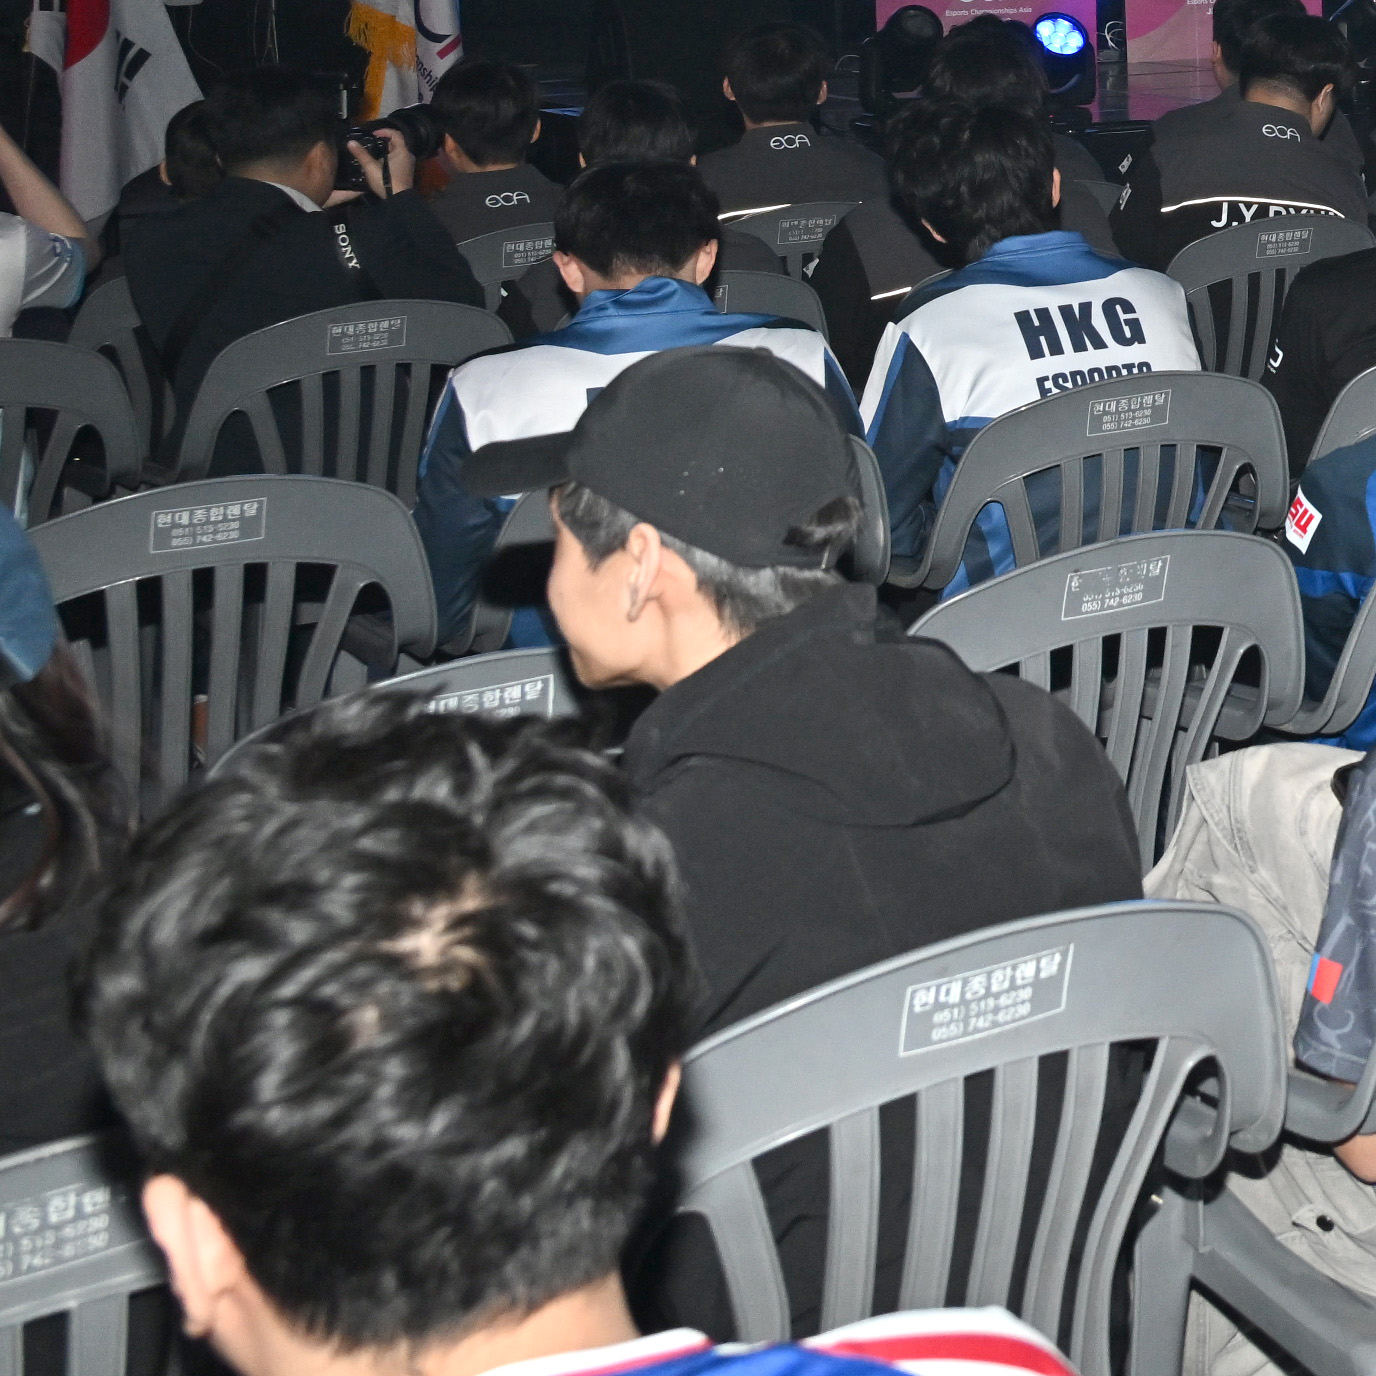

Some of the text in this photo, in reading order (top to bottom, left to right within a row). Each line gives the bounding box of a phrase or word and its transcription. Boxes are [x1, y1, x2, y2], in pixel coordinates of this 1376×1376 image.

[945, 6, 1032, 17] Esports Championships Asia
[770, 134, 811, 149] ECA
[1262, 124, 1300, 142] ECA
[485, 191, 530, 208] ECA
[334, 223, 361, 269] SONY
[1014, 296, 1147, 361] HKG
[1093, 393, 1166, 415] 현대종합렌탈
[1102, 417, 1151, 431] 055) 742-6230
[1103, 414, 1118, 423] 051)
[157, 502, 258, 528] 현대종합렌탈
[1081, 591, 1143, 613] 055) 742-6230
[429, 680, 544, 715] 대종합렌탈
[913, 951, 1063, 1015] 현대종합렌탈
